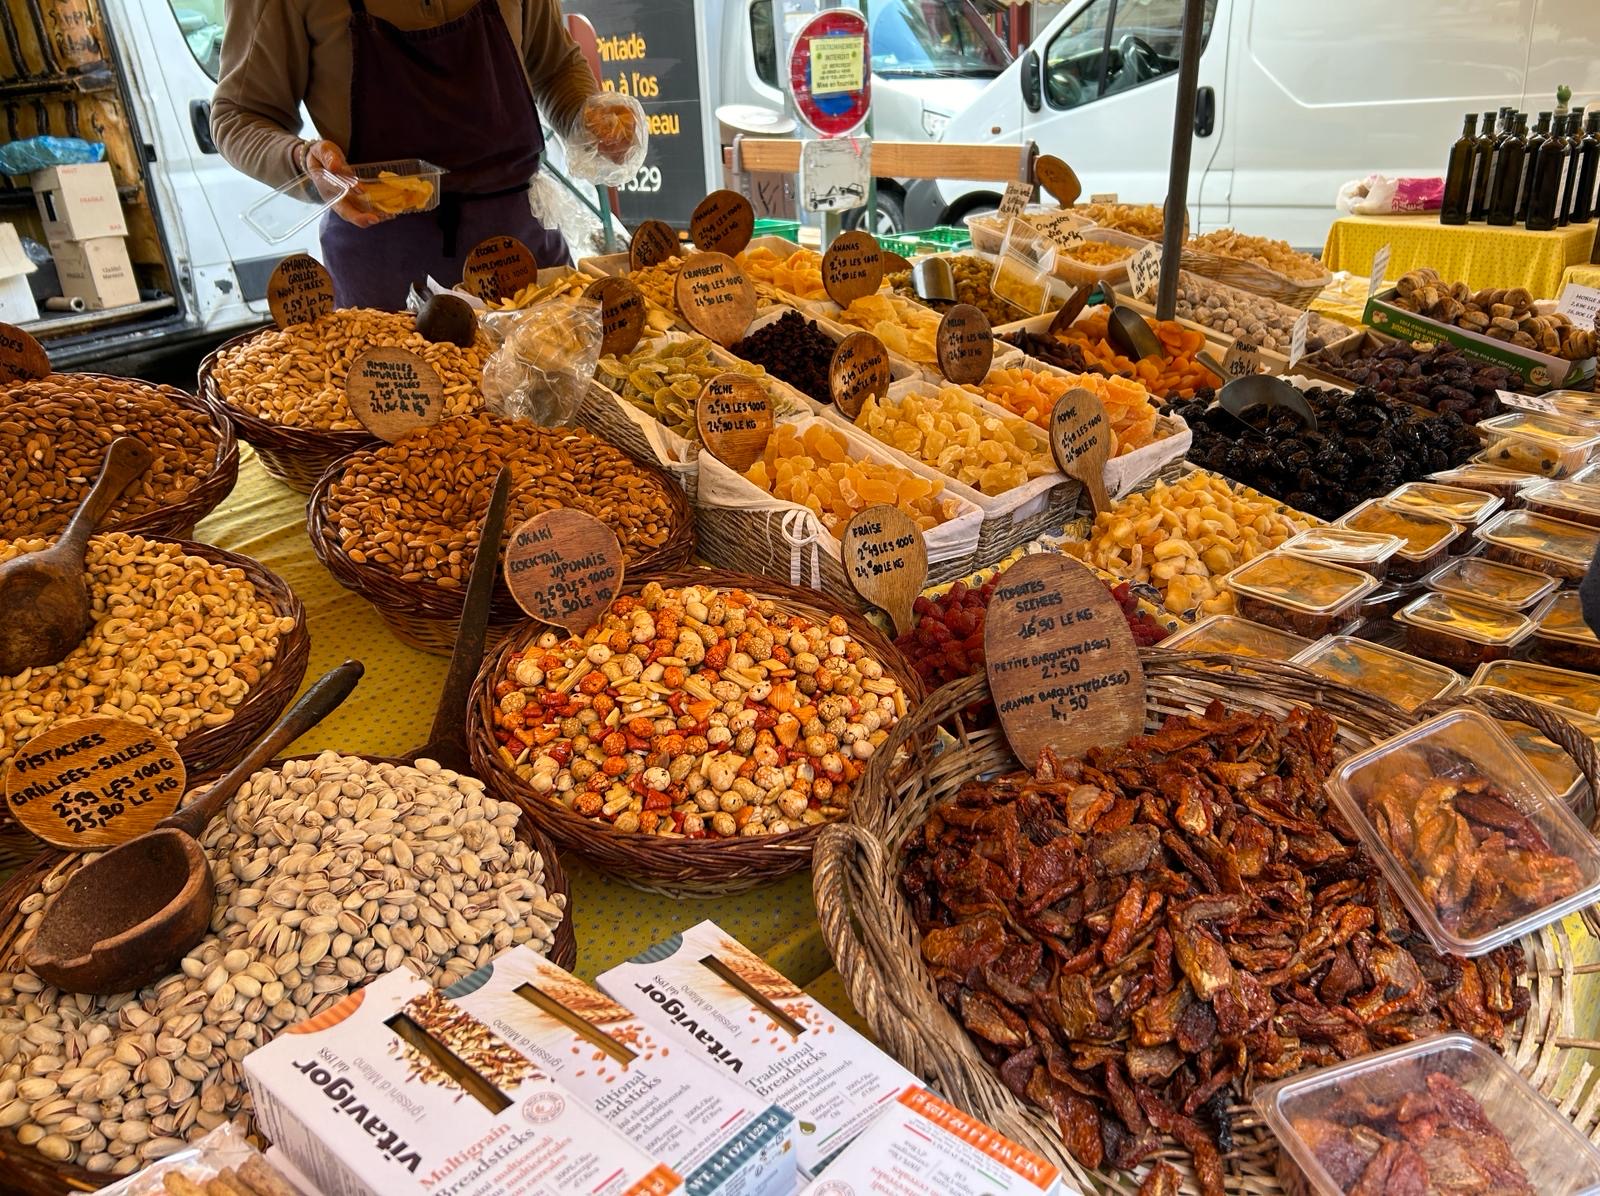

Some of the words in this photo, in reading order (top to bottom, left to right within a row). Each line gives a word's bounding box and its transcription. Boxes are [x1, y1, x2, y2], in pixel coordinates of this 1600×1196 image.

[832, 242, 860, 252] ANANAS
[683, 264, 724, 280] CRANBERRY
[711, 280, 726, 290] LES
[726, 276, 744, 286] 100G
[716, 294, 724, 304] LE
[0, 335, 24, 353] DES
[362, 370, 418, 380] NATURELLES
[366, 360, 412, 372] AMANDES
[709, 380, 734, 396] PÊCHE
[732, 402, 747, 413] LES
[748, 401, 766, 412] 100G
[734, 420, 744, 430] LE
[746, 420, 756, 430] KG
[852, 521, 882, 538] FRAISE
[878, 542, 894, 554] LES
[896, 534, 914, 548] 100G
[995, 580, 1046, 602] TOMATES
[1059, 610, 1074, 627] LE
[1076, 607, 1094, 622] KG
[994, 657, 1030, 674] PETITE
[14, 733, 106, 773] PISTACHES
[101, 776, 136, 799] LES
[134, 758, 175, 780] 100G
[128, 787, 154, 806] LE
[155, 776, 178, 794] KG
[680, 984, 705, 1007] Milano
[493, 1019, 521, 1042] Milano
[634, 982, 744, 1074] vitavigor
[529, 1041, 562, 1066] grissini
[352, 1056, 382, 1084] Milano
[744, 1042, 814, 1090] Traditional
[756, 1050, 828, 1098] Breadsticks
[595, 1069, 646, 1112] ditional
[388, 1088, 424, 1117] grissini
[291, 1058, 422, 1174] vitavigor
[420, 1122, 512, 1191] Multigrain
[729, 1140, 747, 1158] OZ
